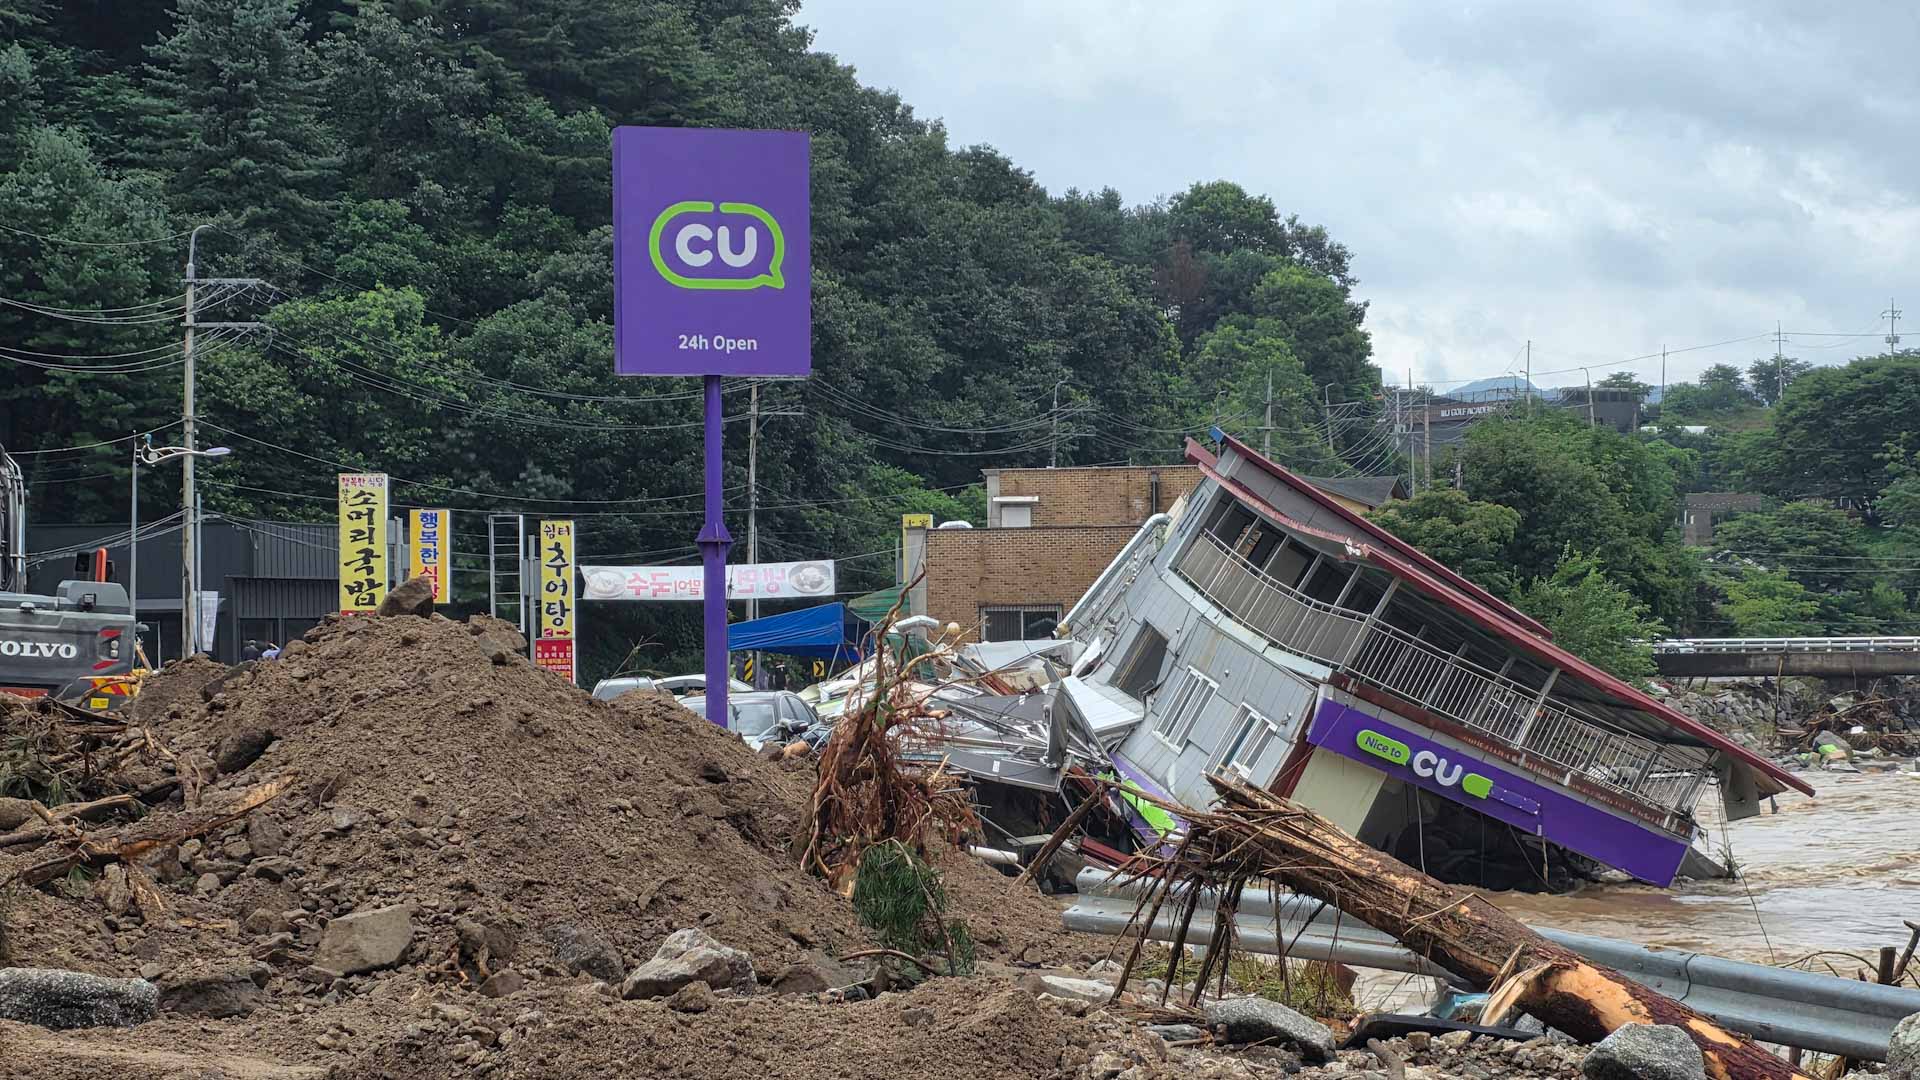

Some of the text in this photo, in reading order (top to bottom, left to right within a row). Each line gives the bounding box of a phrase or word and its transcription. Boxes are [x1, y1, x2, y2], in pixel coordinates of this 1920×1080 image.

[675, 223, 757, 267] CU
[678, 333, 757, 354] 24h Open
[1450, 407, 1467, 416] GOLF
[341, 476, 384, 488] 행복한 식당
[343, 489, 384, 607] 소머리국밥
[418, 511, 439, 565] 행복한
[545, 541, 571, 627] 추어탕
[0, 640, 77, 659] OLVO
[1364, 736, 1403, 759] Nice to
[1412, 750, 1463, 787] CU
